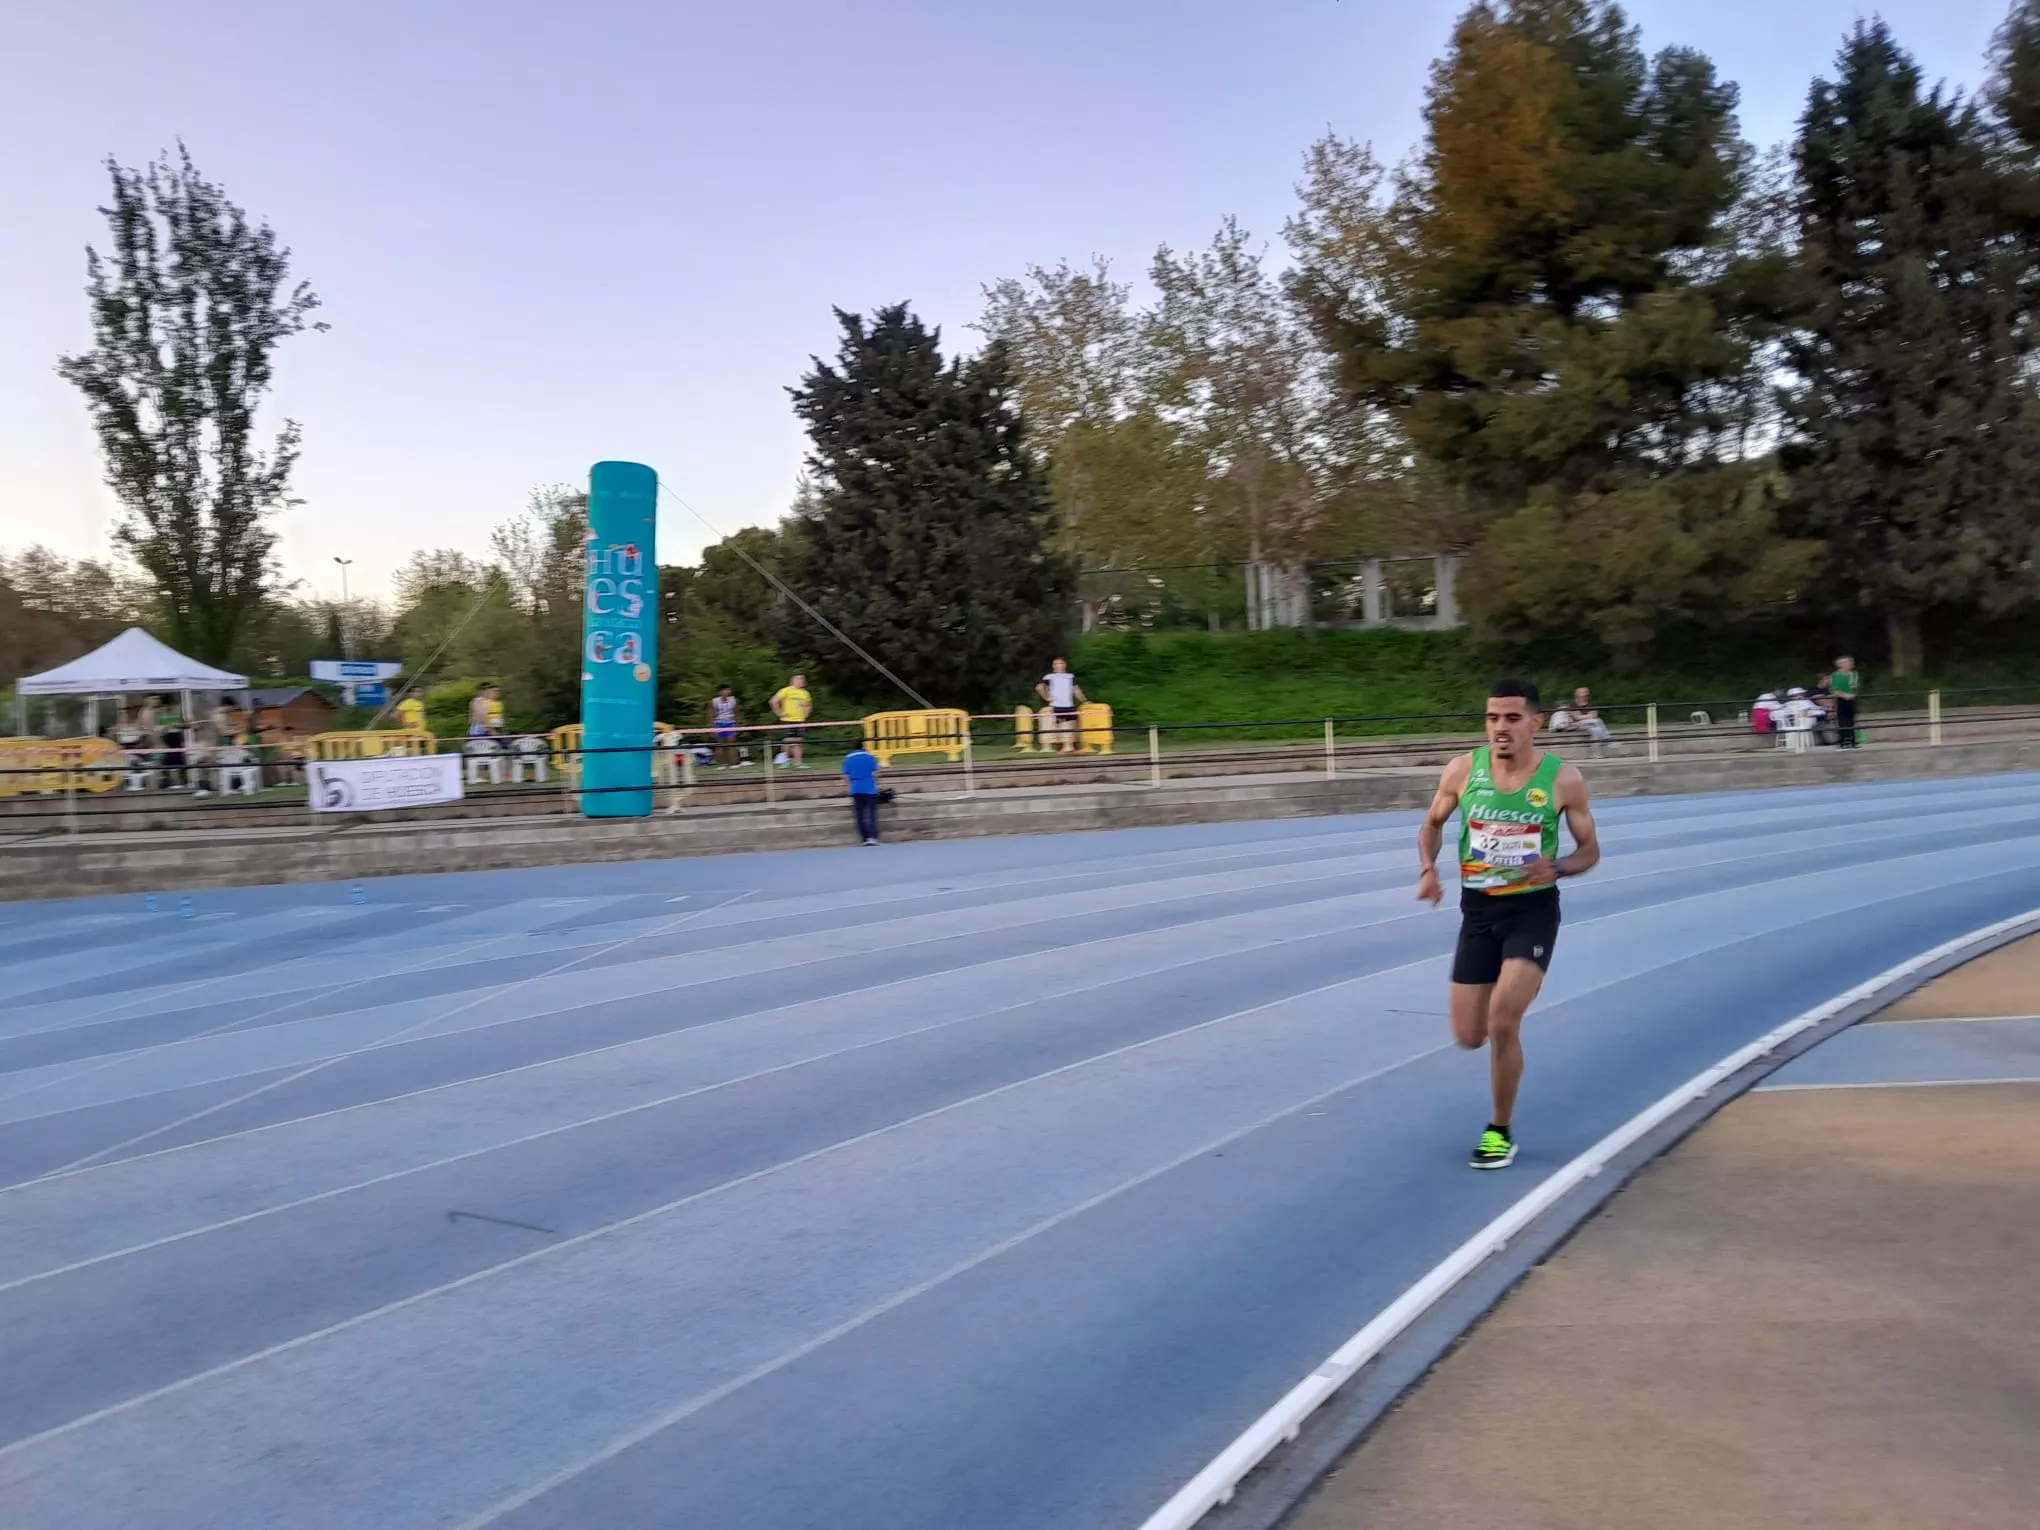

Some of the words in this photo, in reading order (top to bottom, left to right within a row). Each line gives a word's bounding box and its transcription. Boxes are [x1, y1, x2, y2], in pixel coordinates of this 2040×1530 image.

[587, 578, 644, 618] es
[586, 631, 642, 664] ca
[1468, 804, 1544, 823] Huesca
